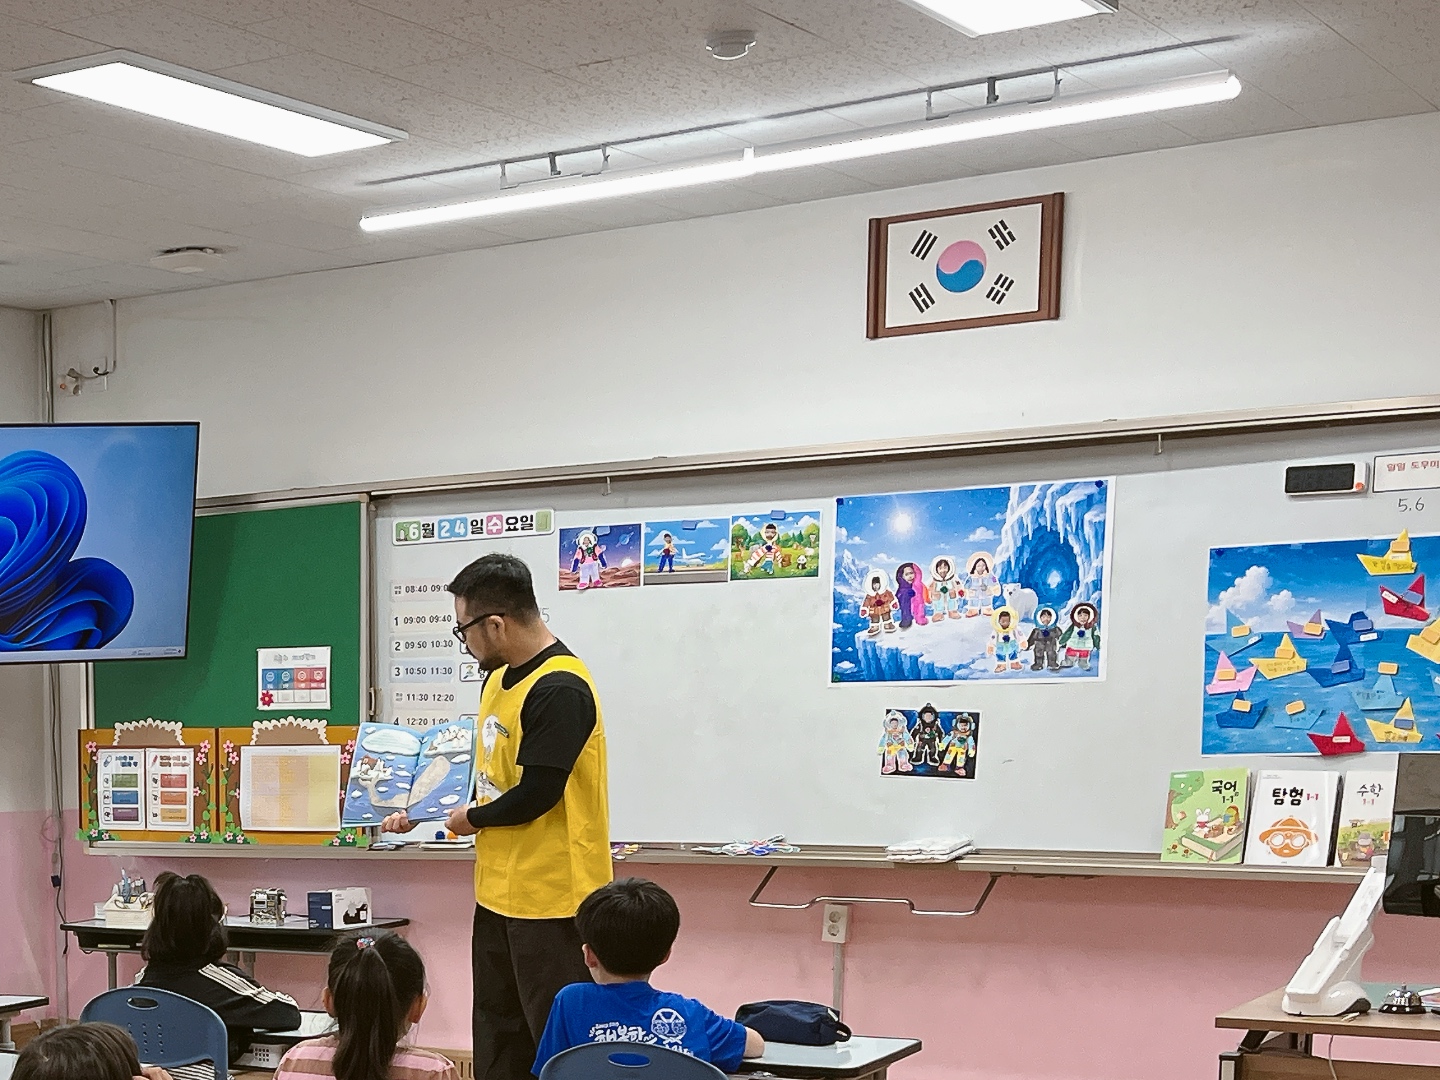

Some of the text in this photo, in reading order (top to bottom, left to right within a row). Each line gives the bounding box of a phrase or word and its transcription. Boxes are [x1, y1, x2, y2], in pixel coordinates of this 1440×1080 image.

[1411, 460, 1440, 469] 도우미
[440, 518, 484, 538] 24일
[486, 514, 535, 534] 수요일
[405, 585, 428, 594] 08:40
[431, 584, 449, 593] 09:0
[394, 615, 452, 626] 1 09:00 09:40
[394, 642, 401, 651] 2
[431, 640, 453, 648] 10:30
[394, 667, 453, 676] 3 10:50 11:30
[407, 693, 429, 702] 11:30
[432, 694, 455, 702] 12:20
[393, 717, 400, 726] 4
[407, 718, 428, 726] 12:20
[1211, 779, 1238, 795] 국어
[1357, 783, 1384, 798] 수학
[1222, 795, 1234, 804] 1-1
[1272, 787, 1319, 806] 탐험 1-1
[1363, 798, 1375, 806] 1-1
